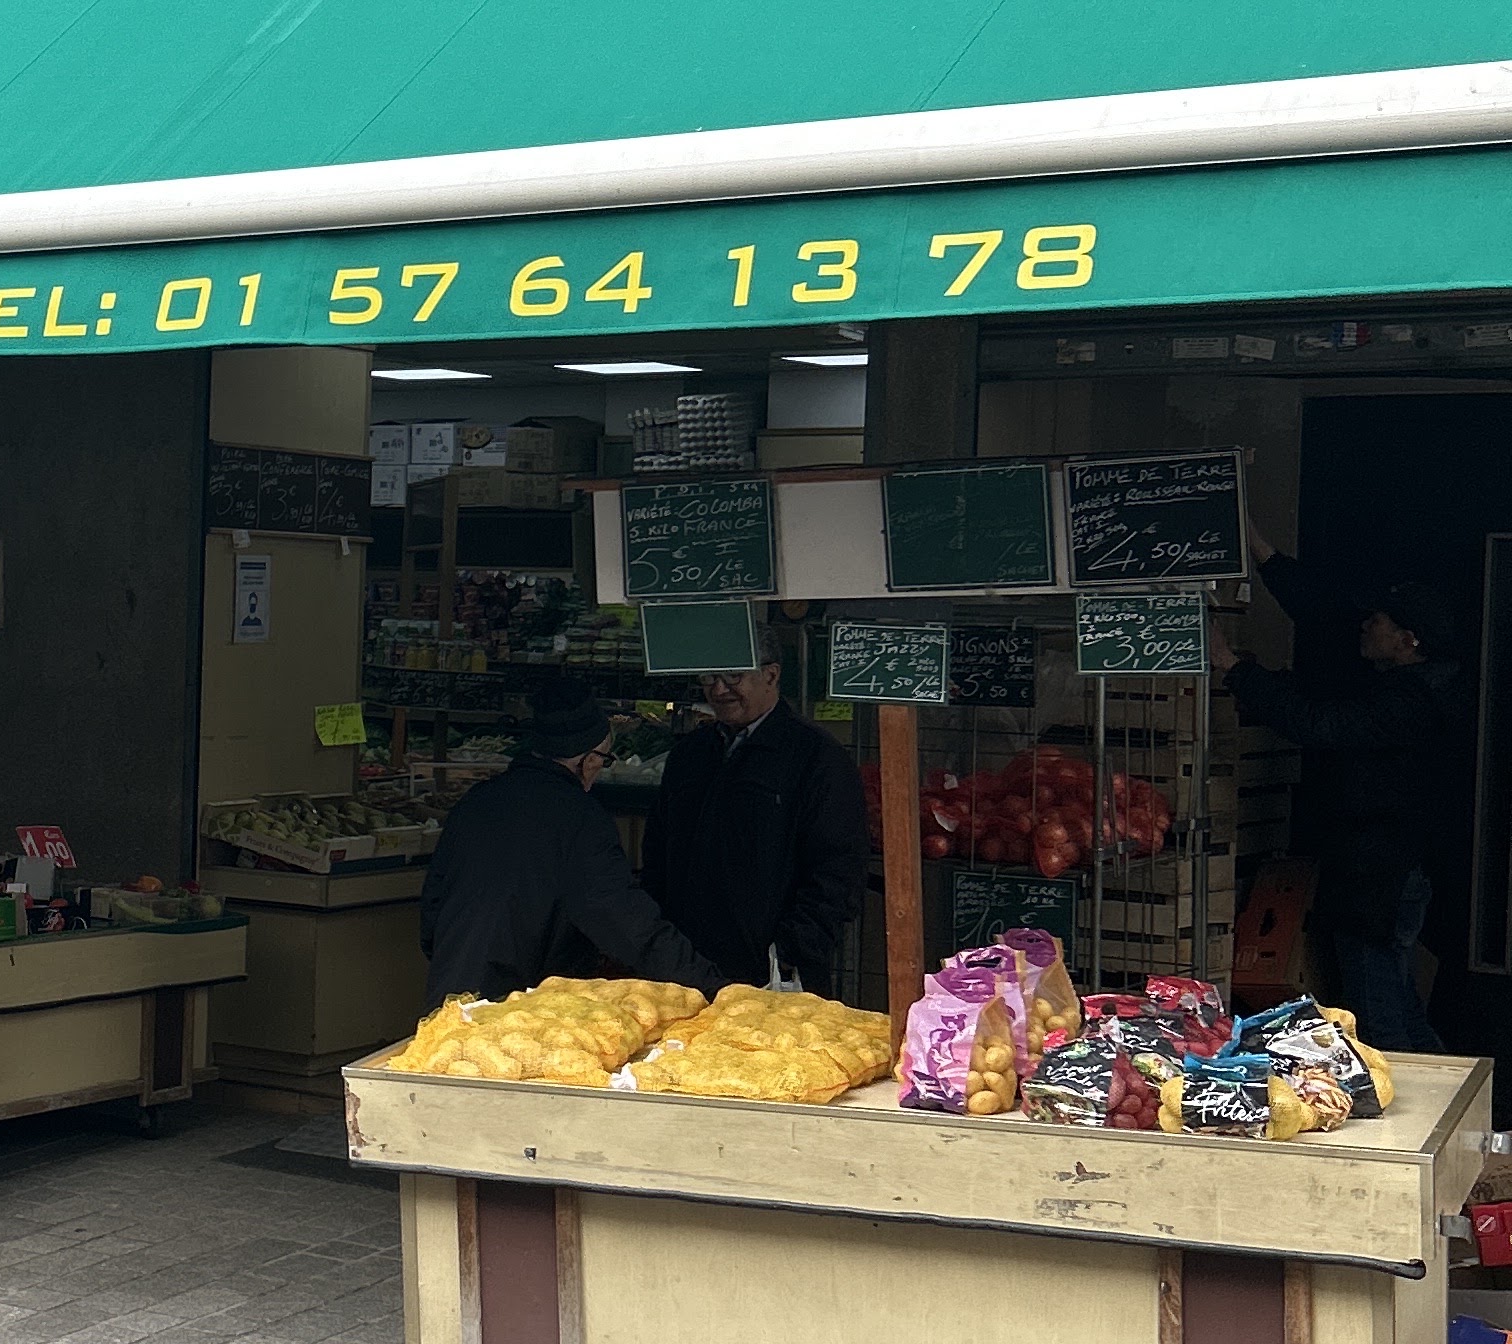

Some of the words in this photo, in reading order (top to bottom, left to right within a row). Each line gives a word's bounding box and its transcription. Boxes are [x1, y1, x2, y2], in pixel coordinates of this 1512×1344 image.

[155, 273, 261, 332] 01
[329, 262, 459, 325] 57
[509, 255, 652, 317] 64
[726, 240, 860, 307] 13
[929, 224, 1097, 296] 78
[1138, 467, 1164, 483] DE
[1169, 462, 1237, 480] TERRE
[678, 496, 763, 519] COLOMBA
[684, 513, 767, 536] FRANCE
[719, 573, 759, 589] SAC
